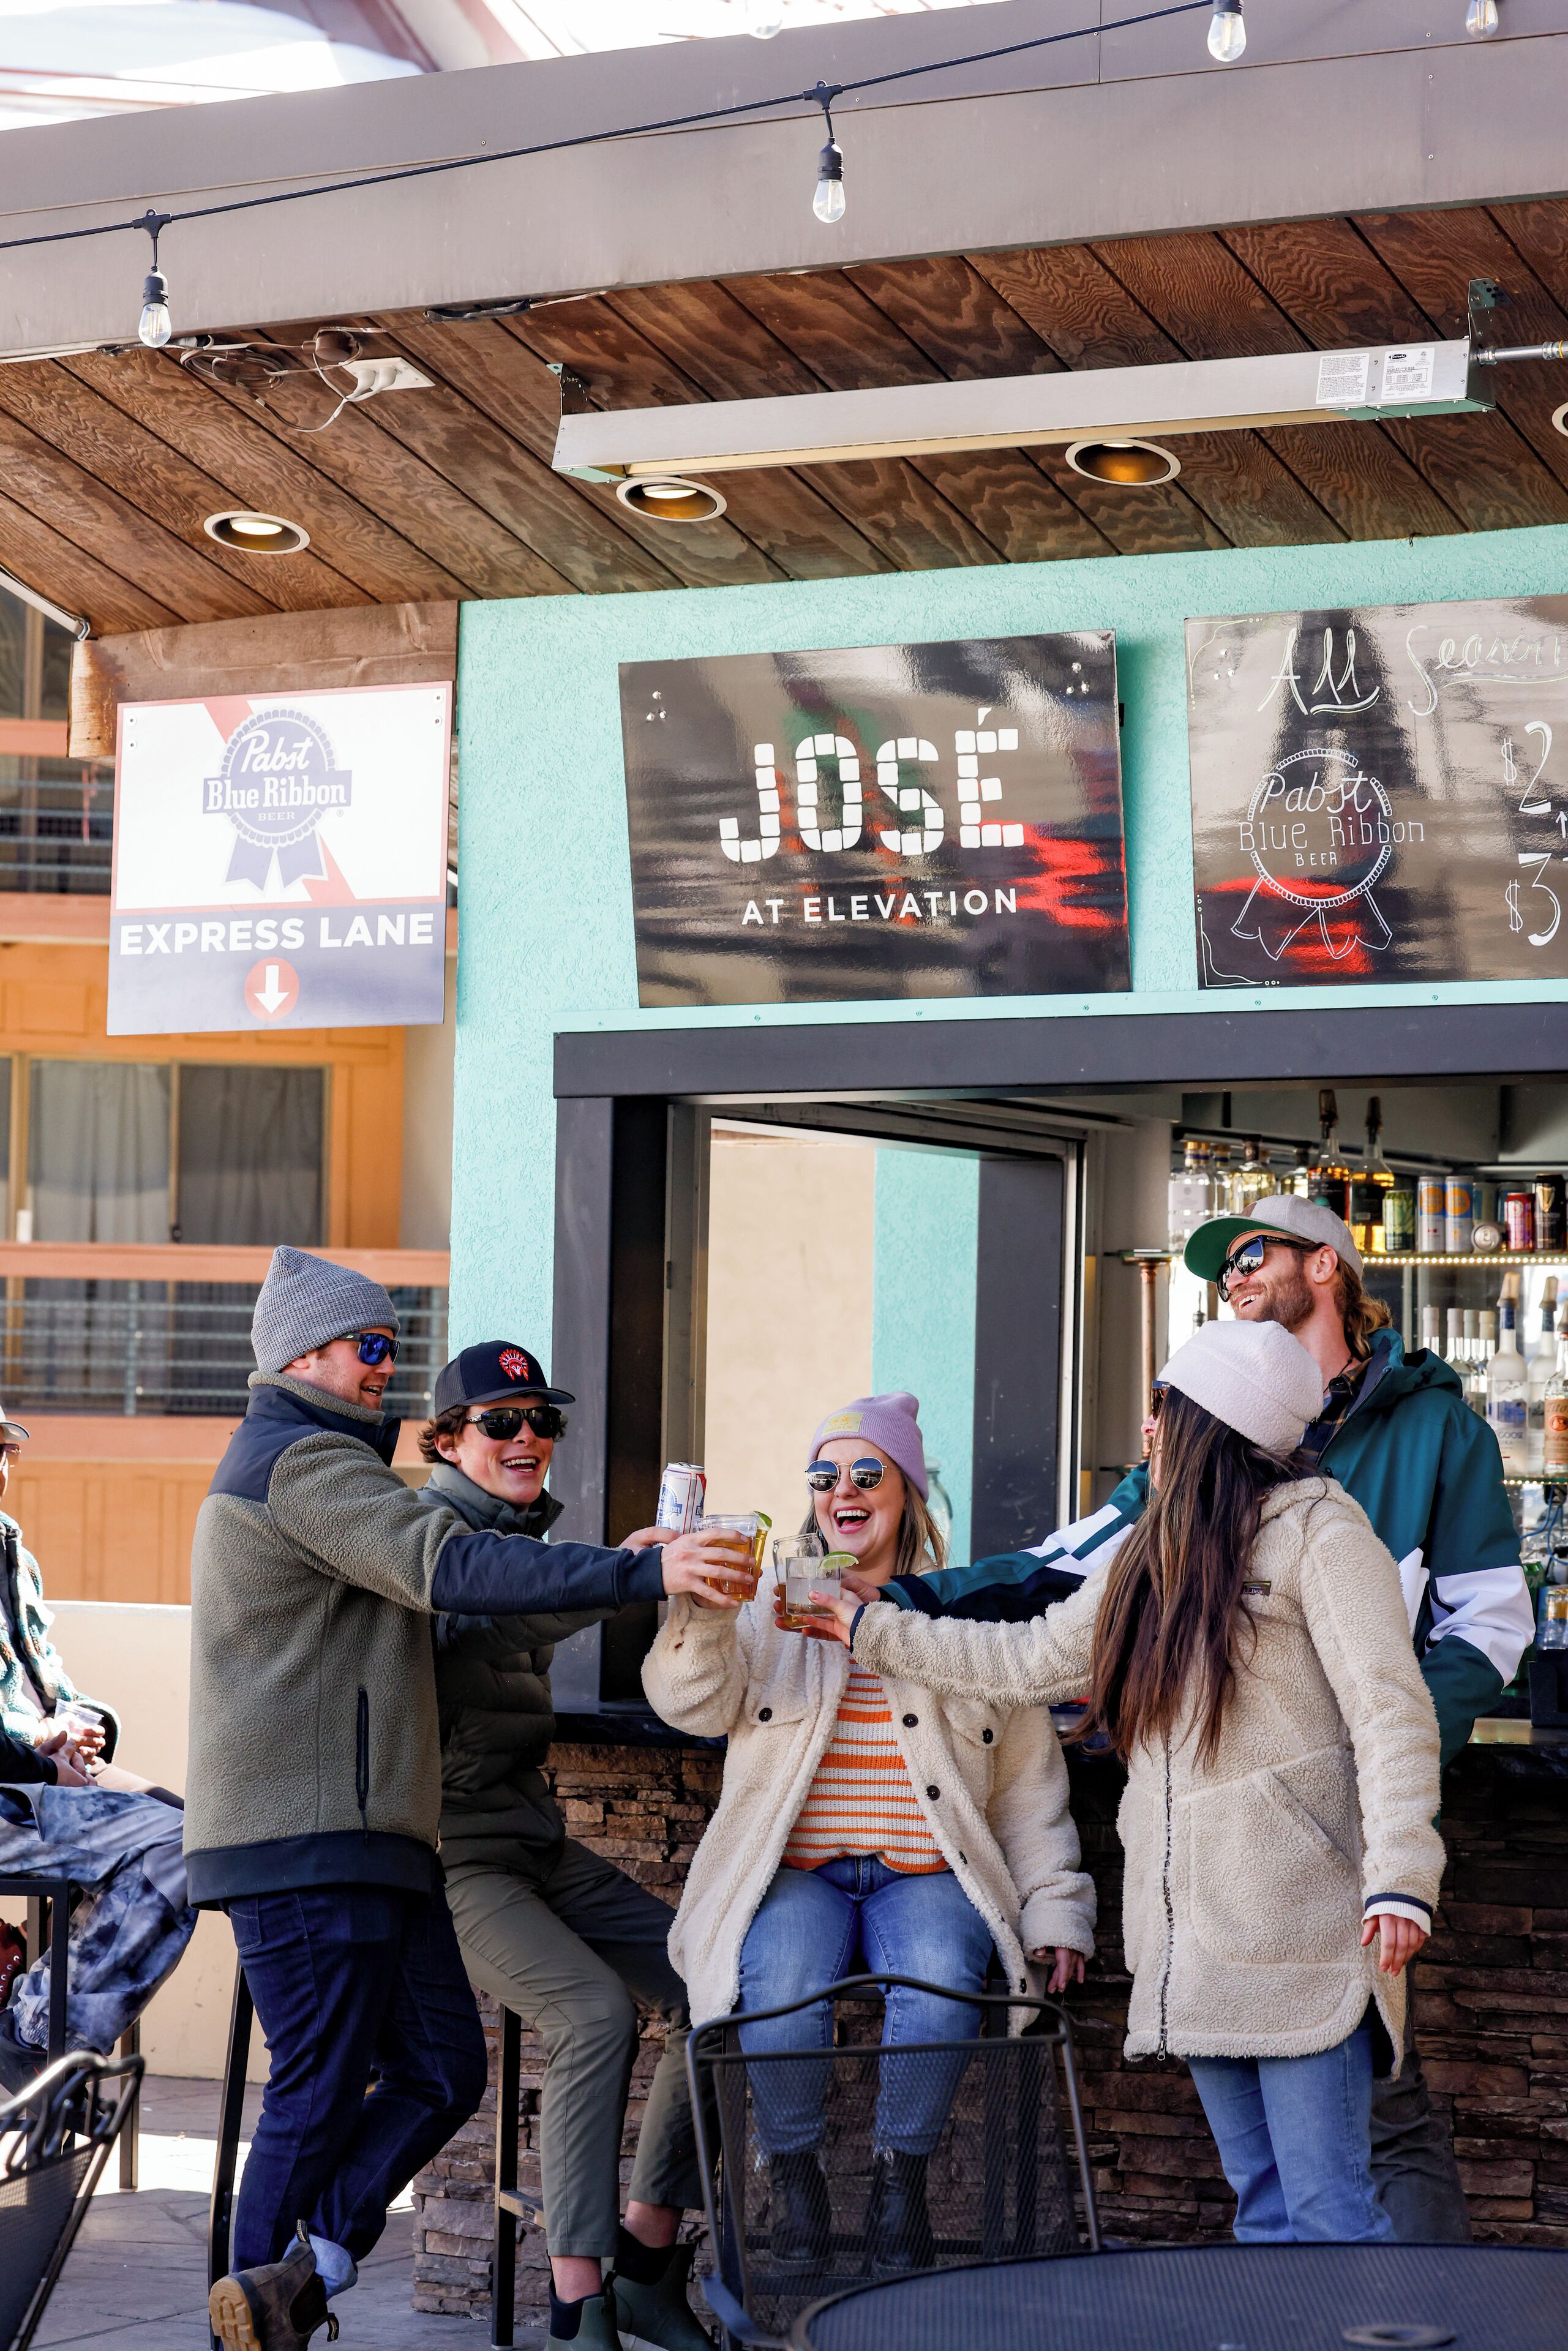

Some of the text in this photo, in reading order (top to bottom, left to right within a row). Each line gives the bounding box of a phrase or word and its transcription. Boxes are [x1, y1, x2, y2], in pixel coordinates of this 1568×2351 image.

[1256, 627, 1370, 715] All
[241, 729, 313, 773] Pabst
[206, 774, 347, 812] Blue Ribbon
[719, 707, 1024, 863] JOSÉ
[1260, 770, 1374, 814] Pabst
[257, 811, 295, 822] BEER
[1239, 815, 1425, 852] Blue Ribbon
[1294, 852, 1338, 867] BEER
[741, 888, 1018, 926] AT ELEVATION
[119, 913, 434, 956] EXPRESS LANE
